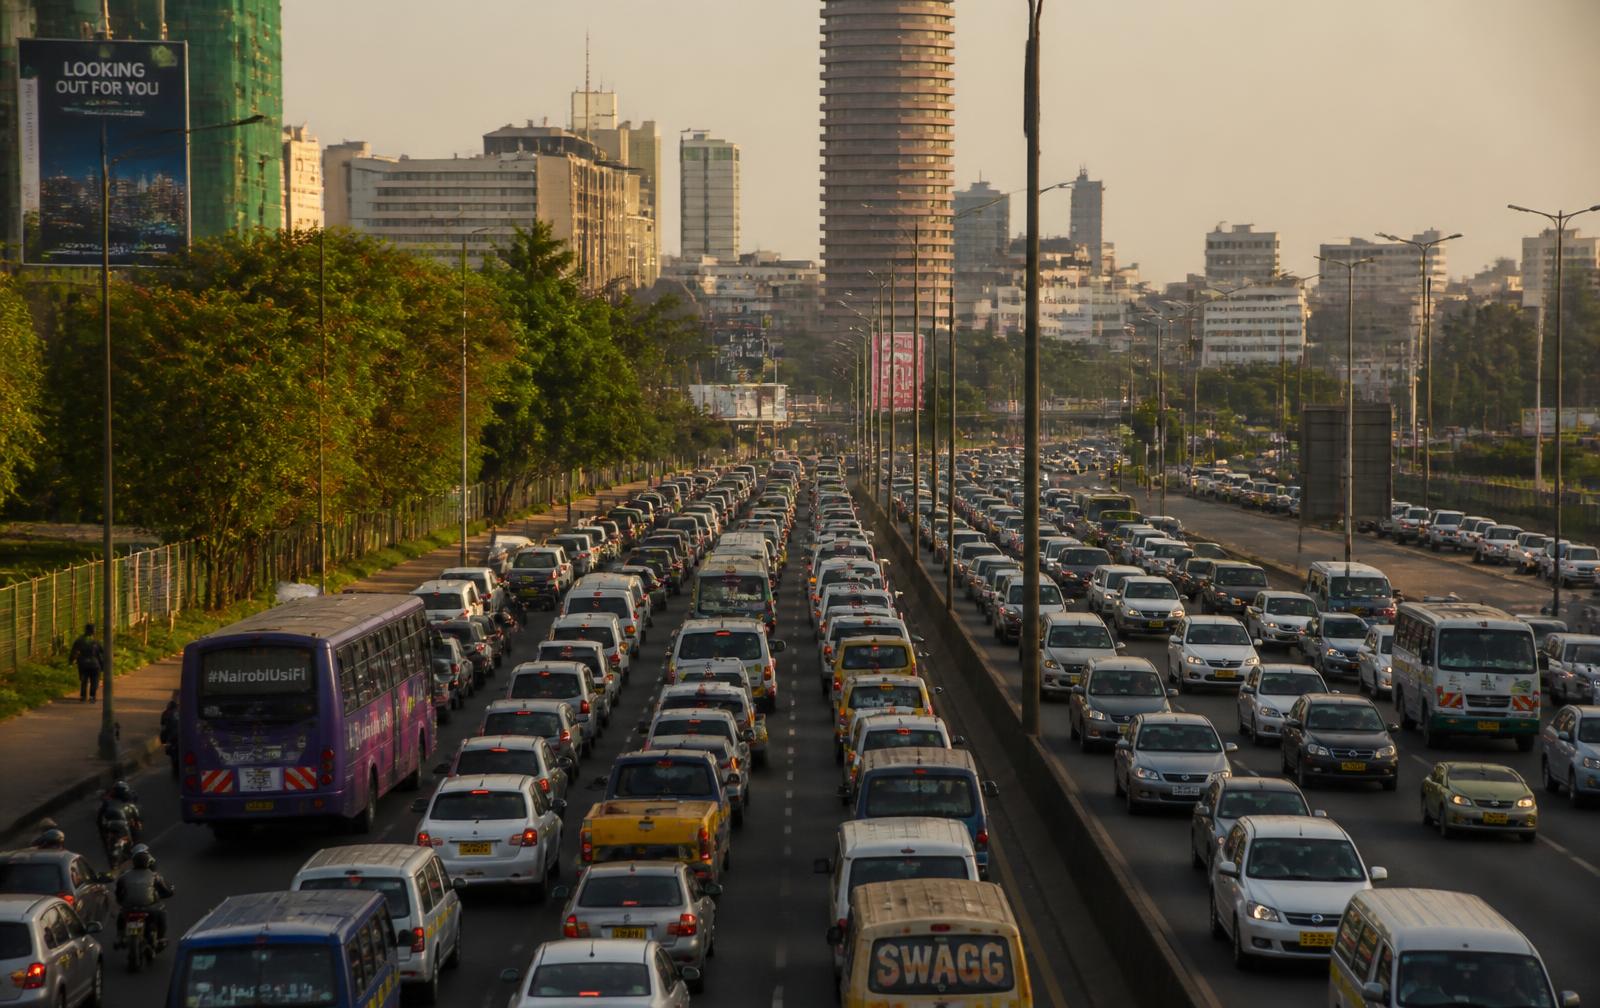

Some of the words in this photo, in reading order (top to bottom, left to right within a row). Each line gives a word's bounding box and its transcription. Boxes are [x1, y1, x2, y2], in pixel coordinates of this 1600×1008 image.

[64, 61, 145, 78] LOOKING
[55, 80, 89, 94] OUT
[92, 81, 122, 95] FOR
[125, 81, 159, 96] YOU
[876, 942, 1005, 987] SWAGG
